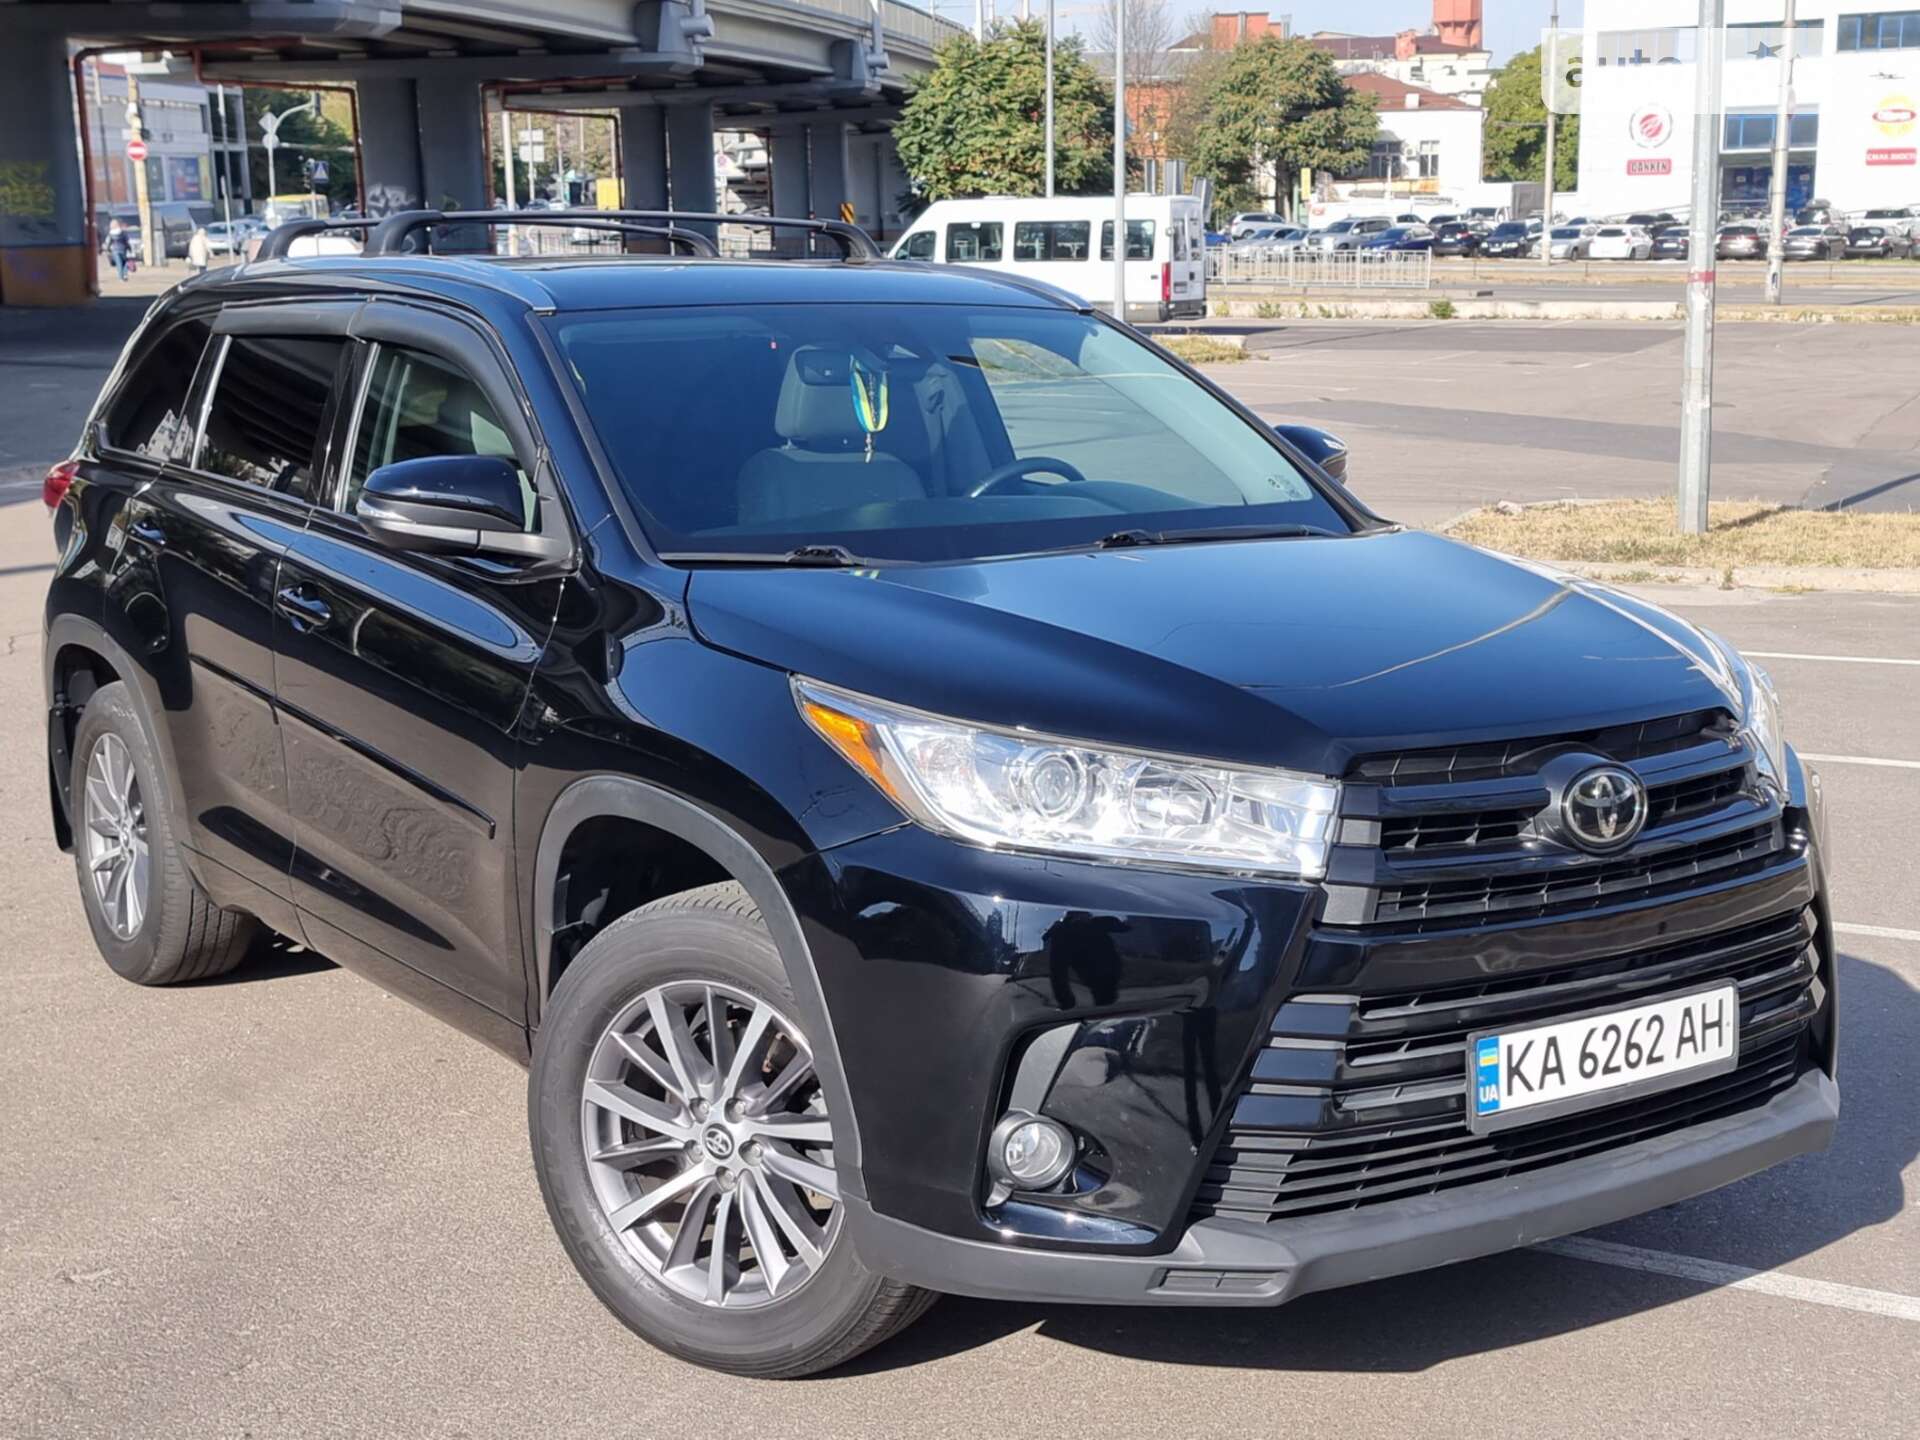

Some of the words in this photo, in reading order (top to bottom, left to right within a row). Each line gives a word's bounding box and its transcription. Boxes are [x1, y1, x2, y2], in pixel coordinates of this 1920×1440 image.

[1506, 1036, 1566, 1096] KA
[1578, 1014, 1664, 1079] 6262
[1675, 998, 1724, 1059] AH
[1480, 1084, 1499, 1103] UA
